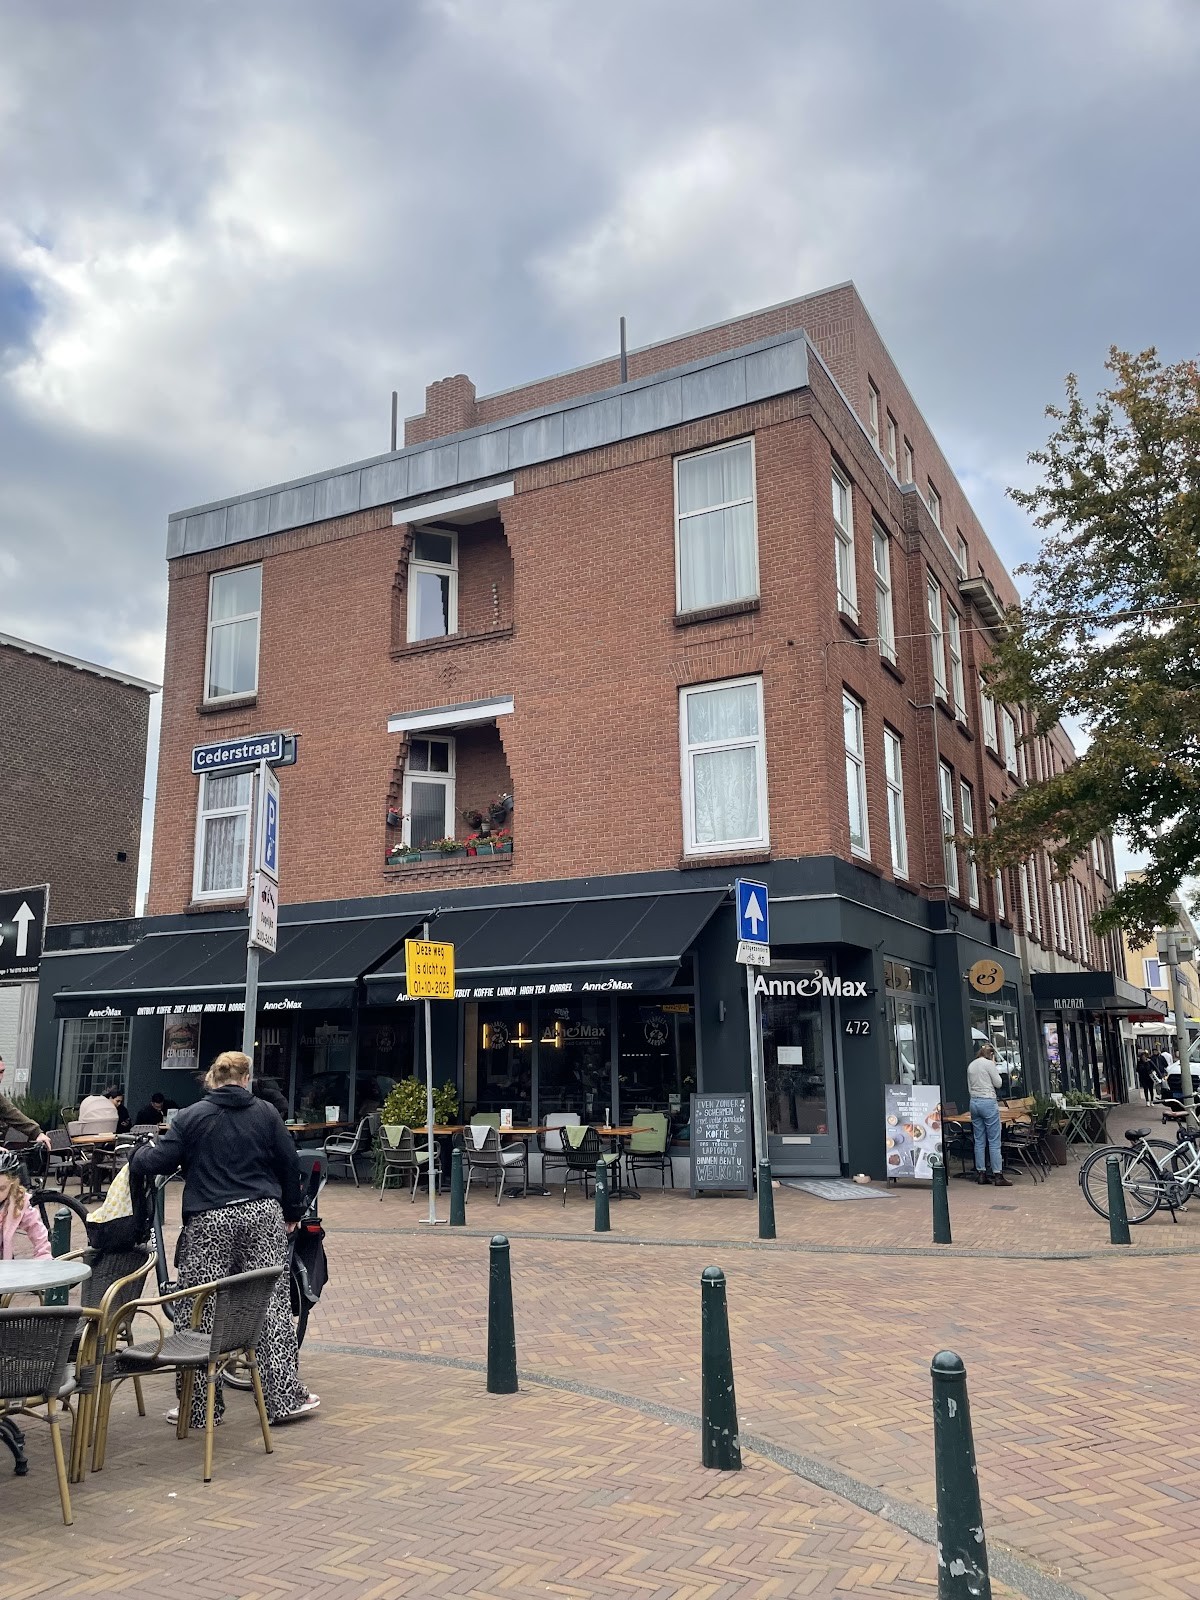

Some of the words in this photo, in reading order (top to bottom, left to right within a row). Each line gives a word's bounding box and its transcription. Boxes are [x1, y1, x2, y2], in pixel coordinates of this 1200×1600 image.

[197, 740, 277, 765] Cederstraat
[416, 942, 432, 955] Deze
[433, 946, 444, 960] weg
[423, 962, 438, 975] dicht
[440, 966, 446, 977] op
[413, 980, 450, 994] 01-10-2025
[473, 987, 494, 997] KOFFIE
[497, 986, 517, 997] LUNCH
[520, 985, 535, 995] HIGH
[535, 984, 546, 994] TEA
[549, 983, 573, 993] BORREL
[156, 1005, 172, 1015] KOFFIE
[173, 1004, 186, 1014] ZOET
[187, 1003, 203, 1013] LUNCH
[204, 1003, 217, 1012] HIGH
[217, 1003, 227, 1012] TEA
[1053, 998, 1084, 1009] ALAZAZA
[845, 1020, 870, 1035] 472
[167, 1048, 178, 1058] EEN
[178, 1048, 196, 1058] LIEFDE
[716, 1099, 739, 1108] ZONDER
[704, 1108, 734, 1117] SCHERMEN
[705, 1130, 730, 1139] KOFFIE
[697, 1156, 717, 1165] BINNEN
[719, 1156, 735, 1165] BENT
[736, 1157, 742, 1166] U
[696, 1165, 745, 1181] WELKOM
